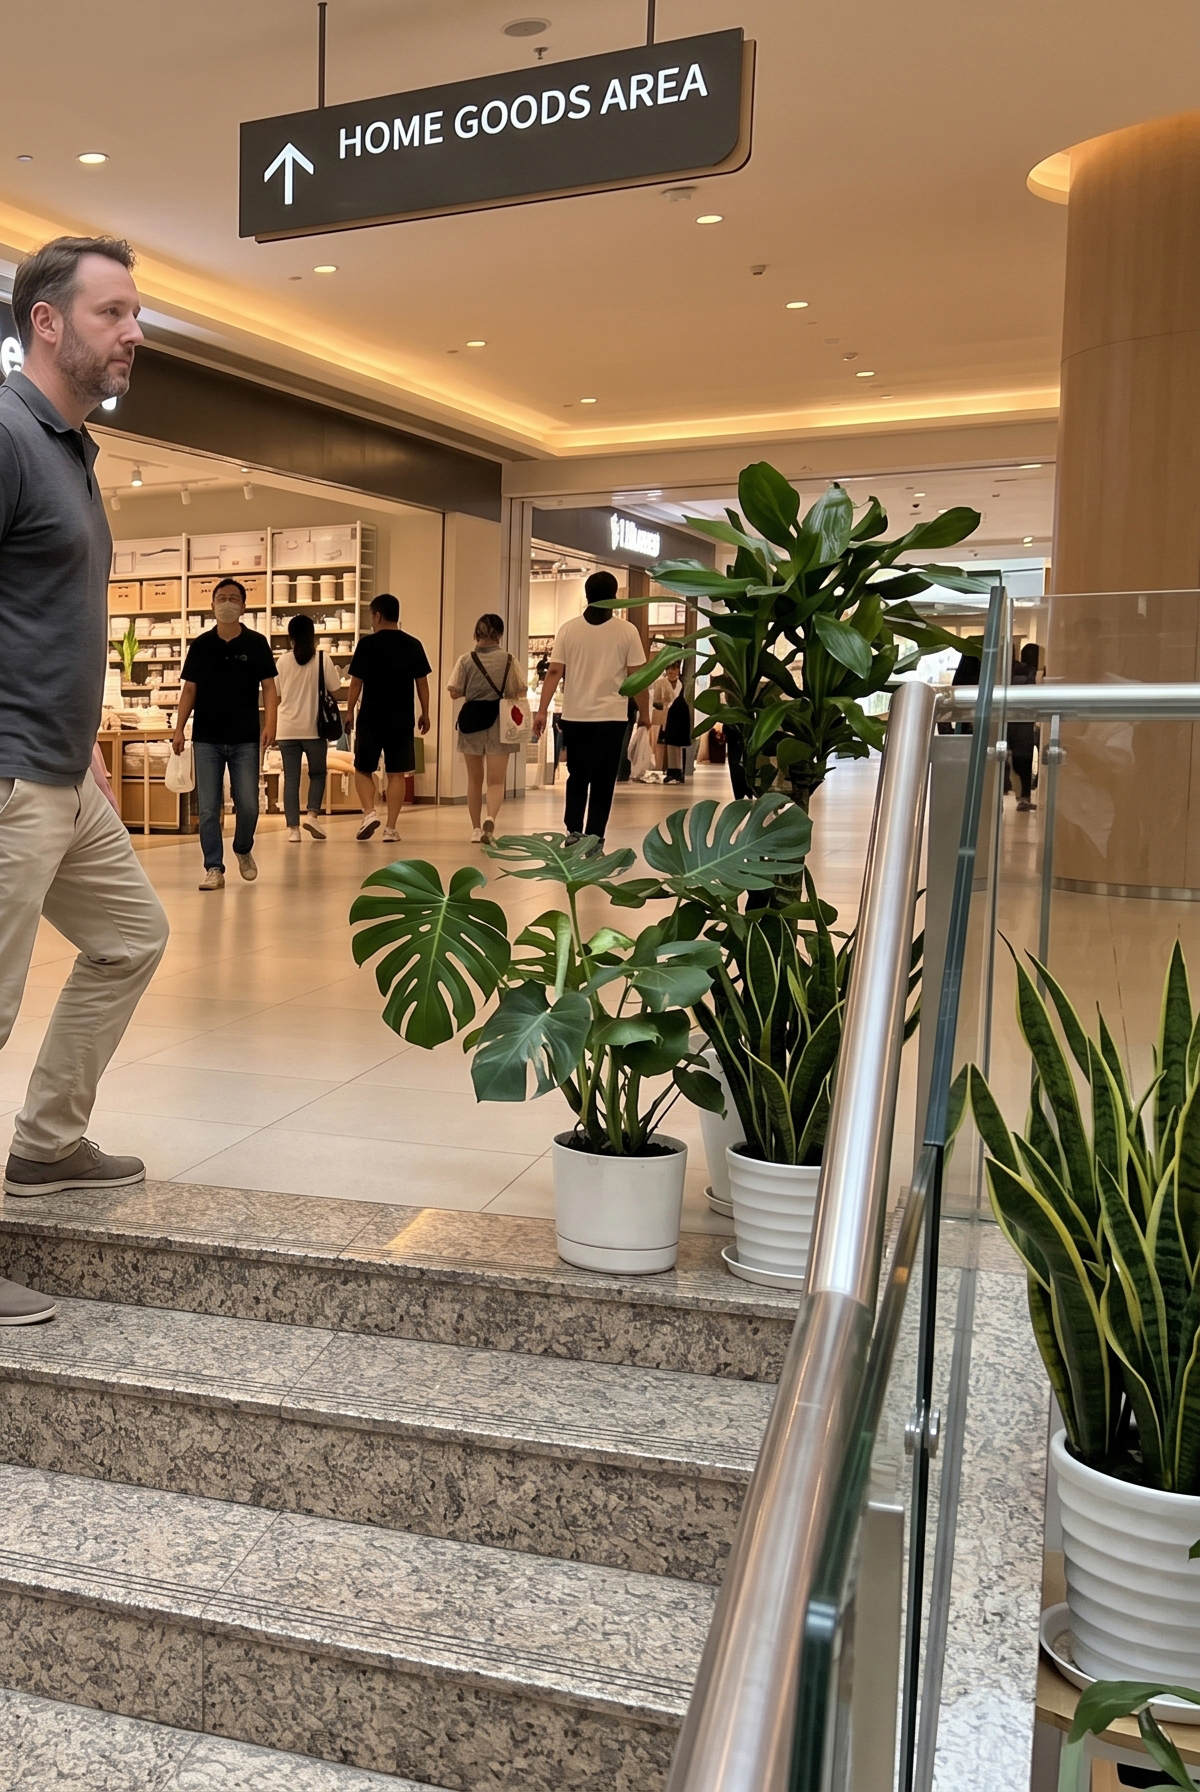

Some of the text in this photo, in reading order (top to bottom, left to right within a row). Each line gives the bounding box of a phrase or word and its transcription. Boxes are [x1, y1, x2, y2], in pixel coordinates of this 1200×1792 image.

[339, 63, 708, 159] HOME GOODS AREA
